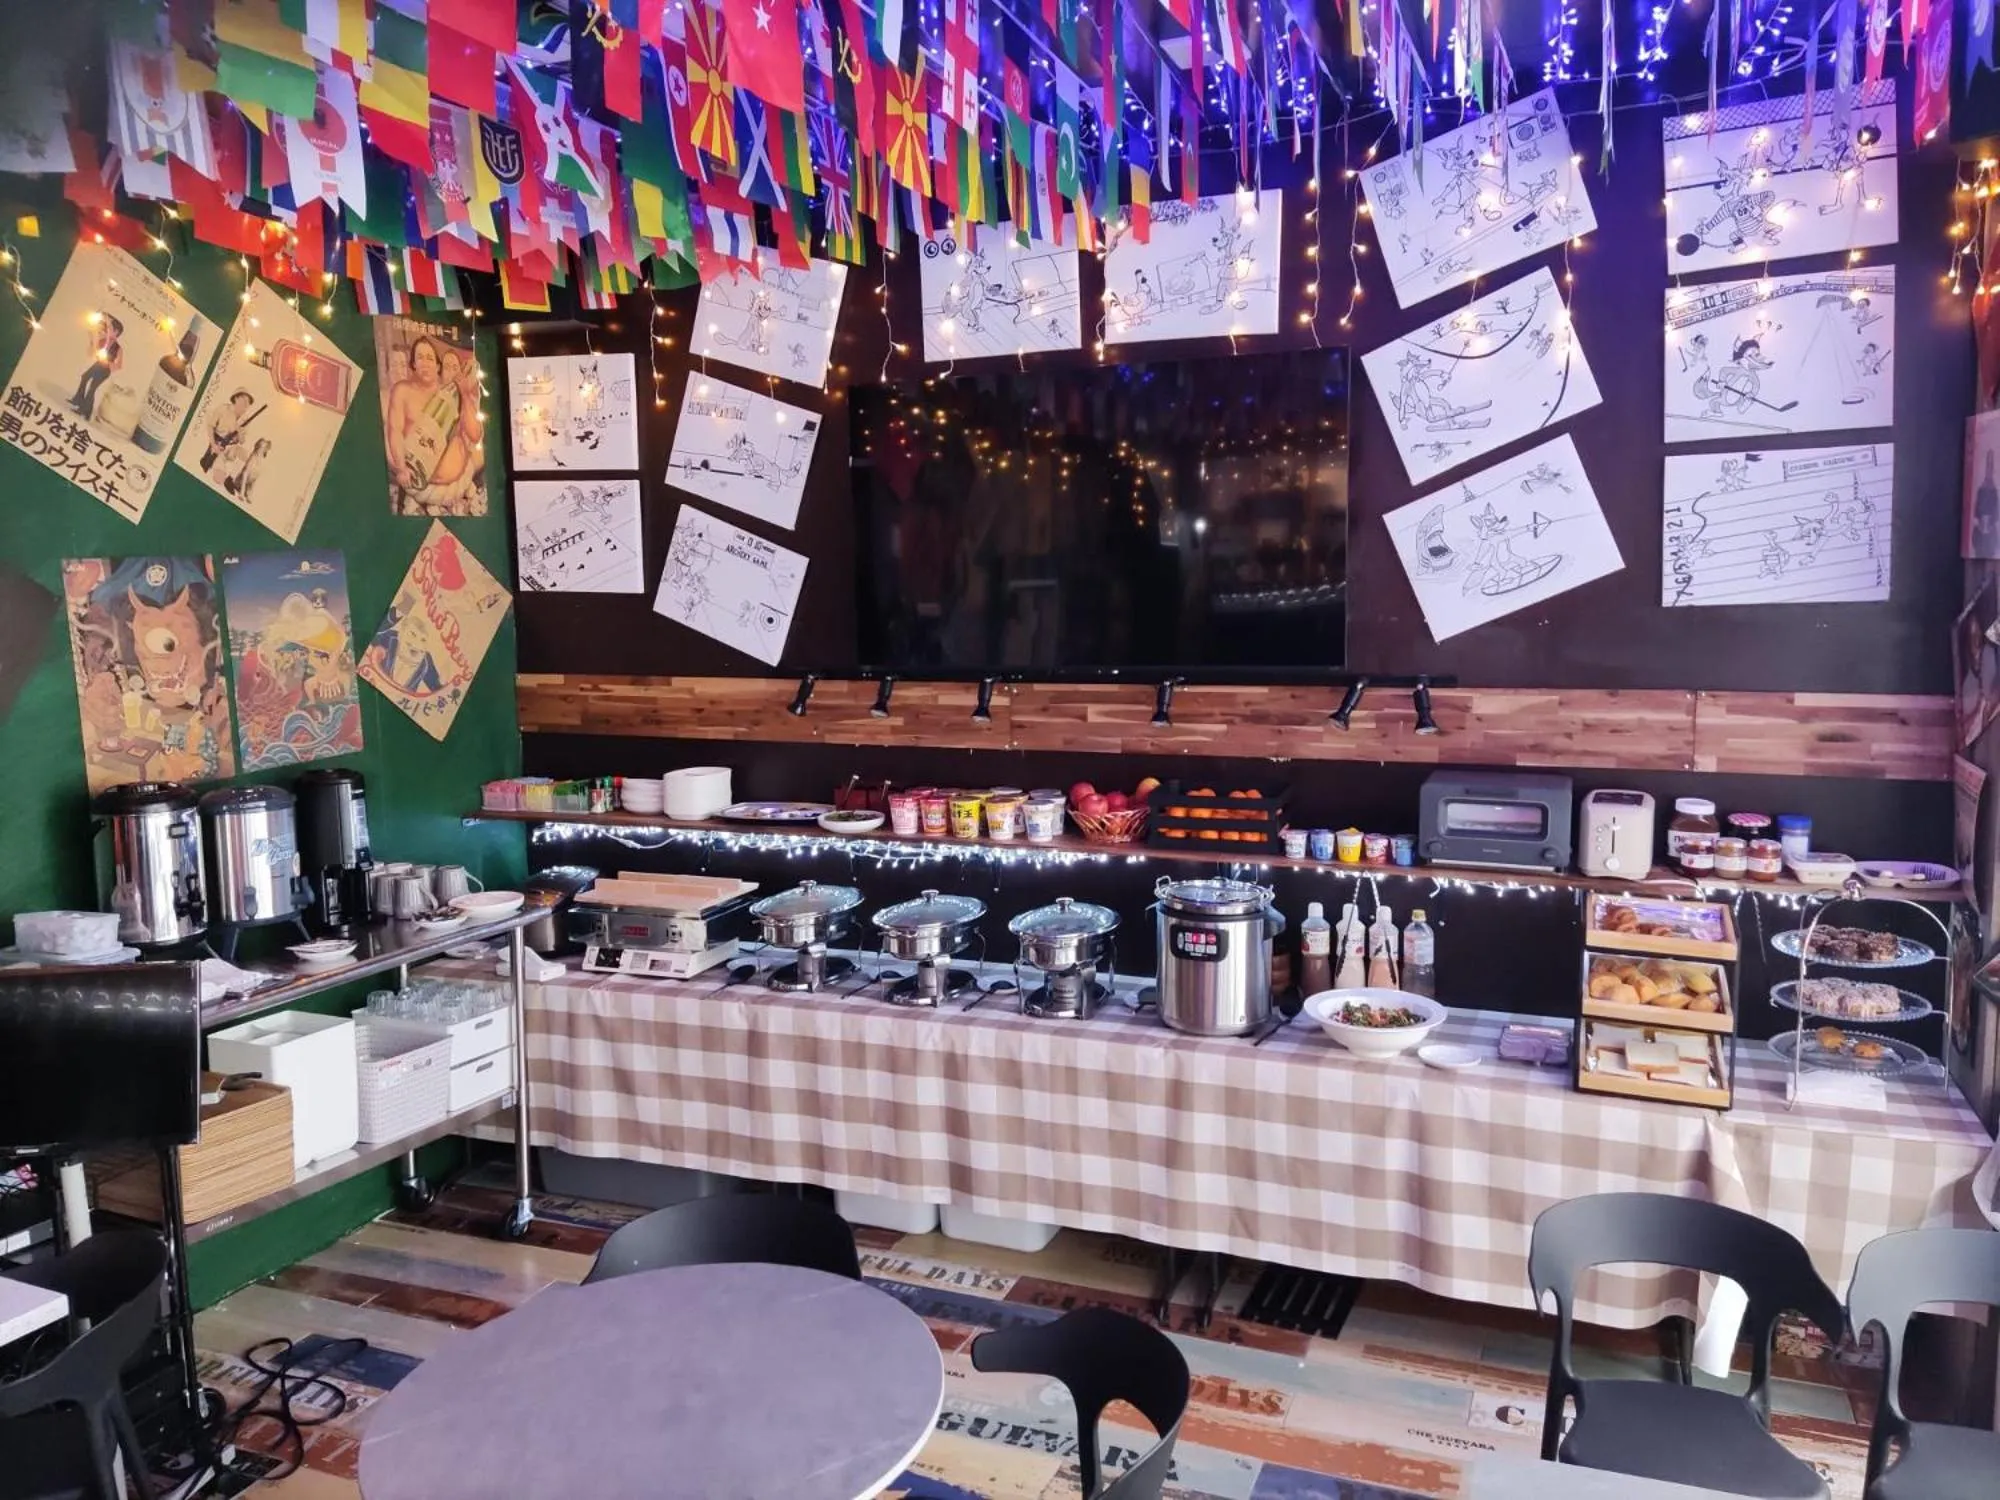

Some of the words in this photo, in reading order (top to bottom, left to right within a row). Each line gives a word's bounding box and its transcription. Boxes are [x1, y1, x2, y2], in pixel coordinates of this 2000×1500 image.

[0, 410, 139, 512] 男のウイスキー
[4, 385, 129, 480] 飾りを捨てた
[926, 1264, 1010, 1292] DAYS
[1407, 1427, 1433, 1439] CHE
[1437, 1433, 1496, 1452] GUEVARA
